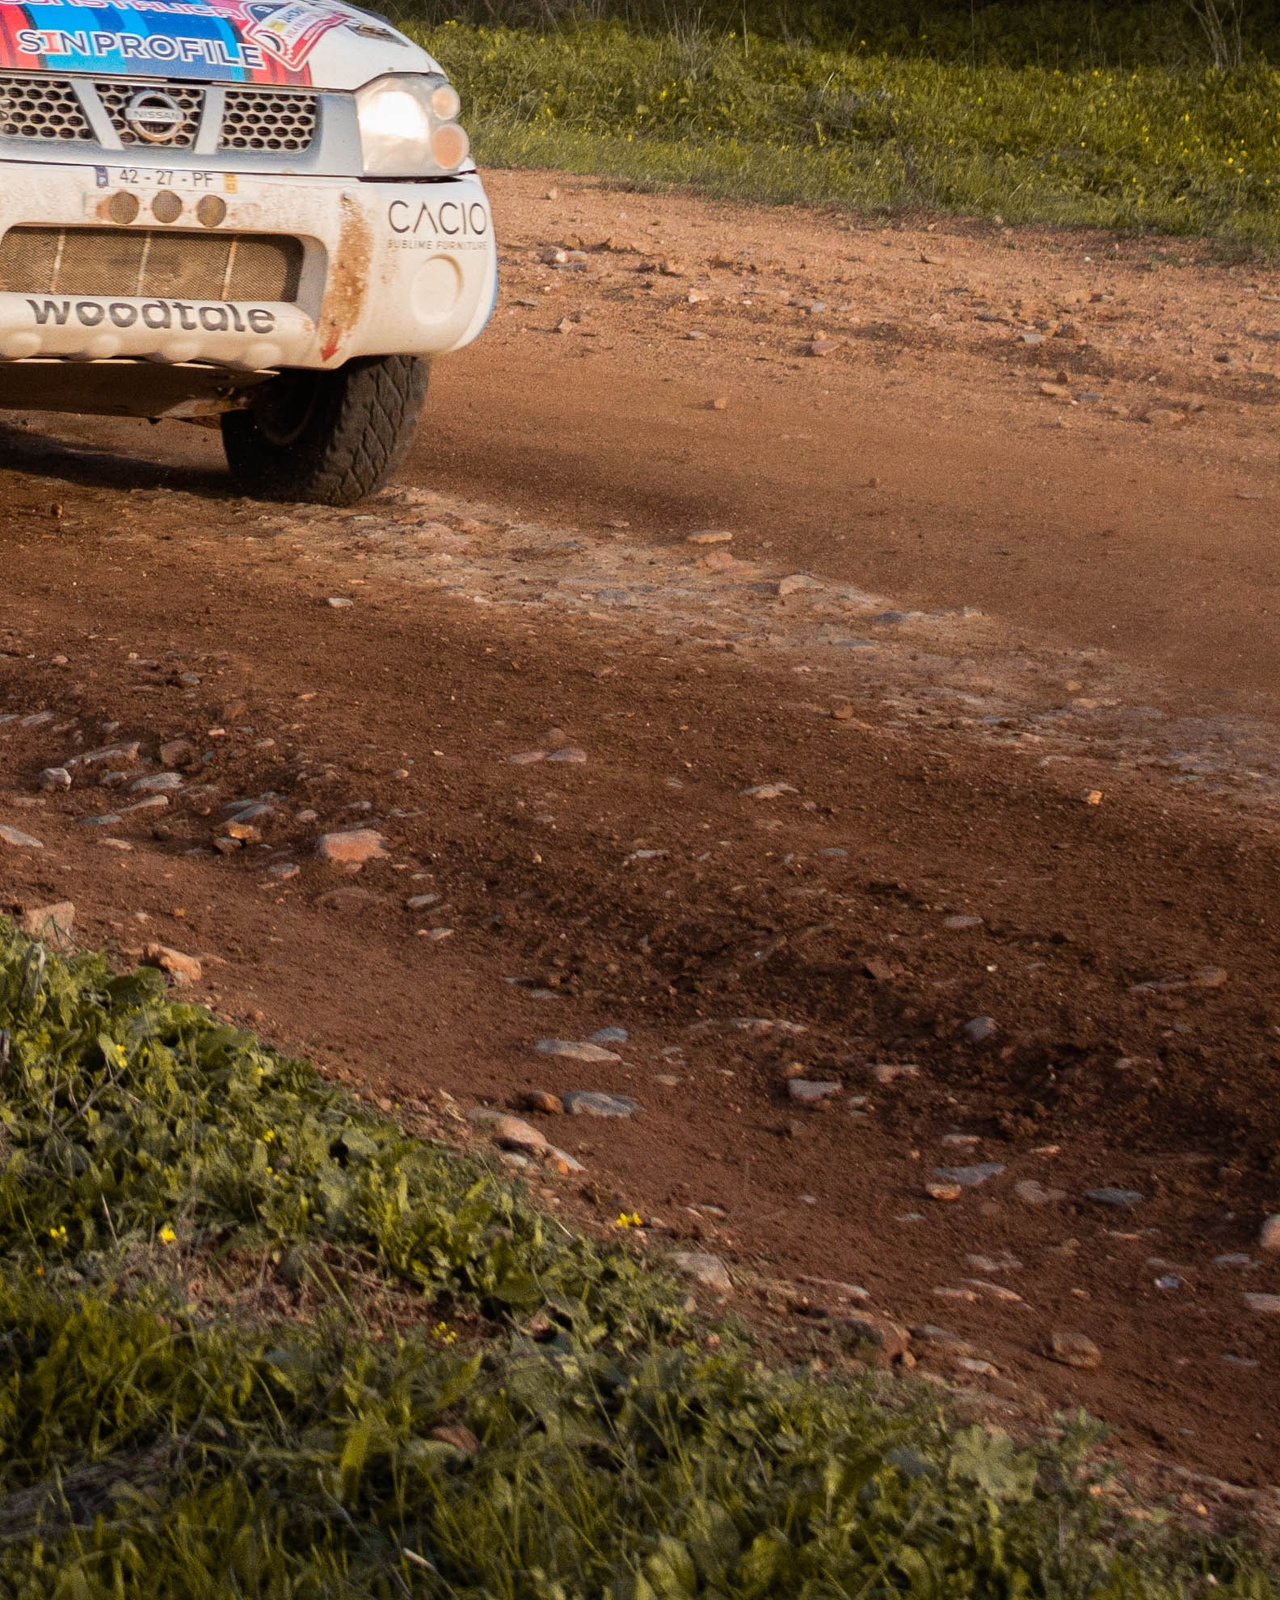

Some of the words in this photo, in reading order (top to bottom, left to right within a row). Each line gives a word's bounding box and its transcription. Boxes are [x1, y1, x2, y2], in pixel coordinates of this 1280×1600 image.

[16, 29, 267, 70] SINPROFILE
[134, 109, 181, 121] NISSAN
[388, 200, 487, 235] CACIO
[387, 239, 433, 249] SUBLIME
[437, 240, 488, 250] FURNITURE
[25, 299, 277, 334] woodtale
